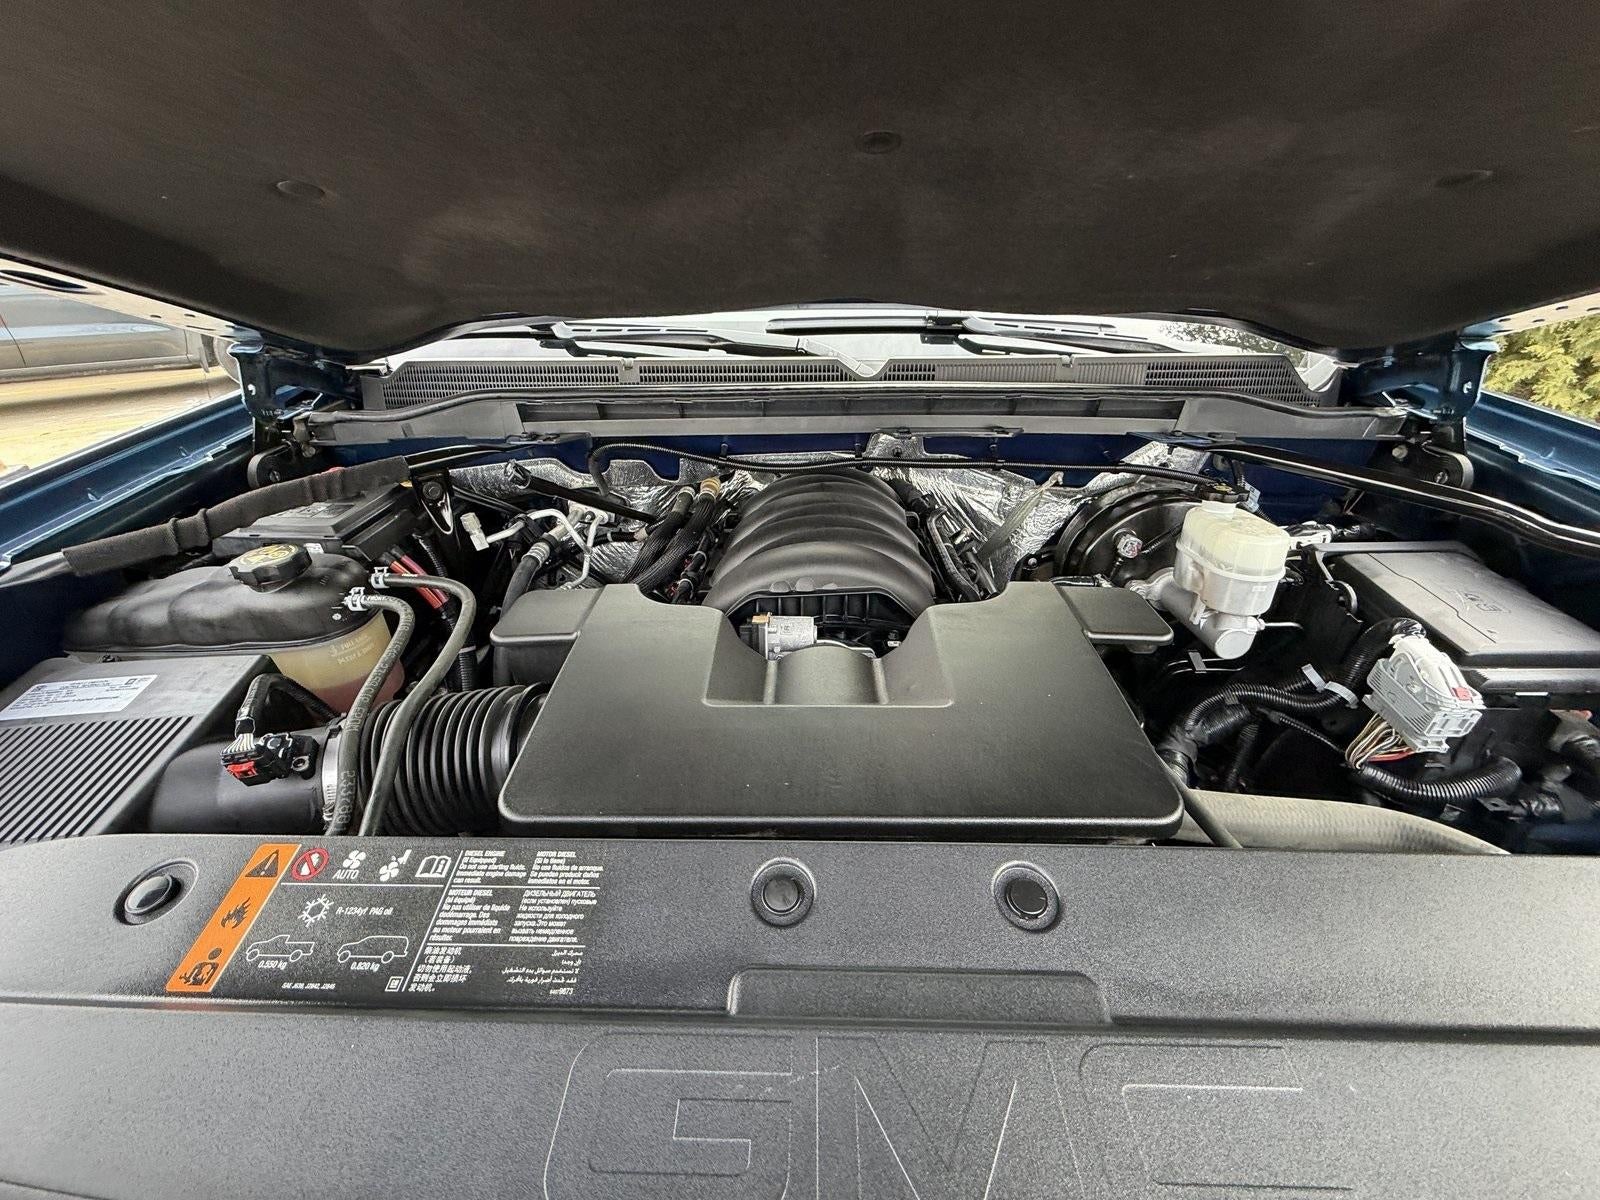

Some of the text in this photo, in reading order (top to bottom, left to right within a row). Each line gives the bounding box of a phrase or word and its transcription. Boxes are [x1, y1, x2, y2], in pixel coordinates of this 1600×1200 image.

[332, 869, 359, 880] AUTO
[369, 907, 384, 915] PAG
[258, 960, 287, 970] 0.550 kg
[370, 962, 380, 972] kg
[543, 1032, 1354, 1200] GMC
